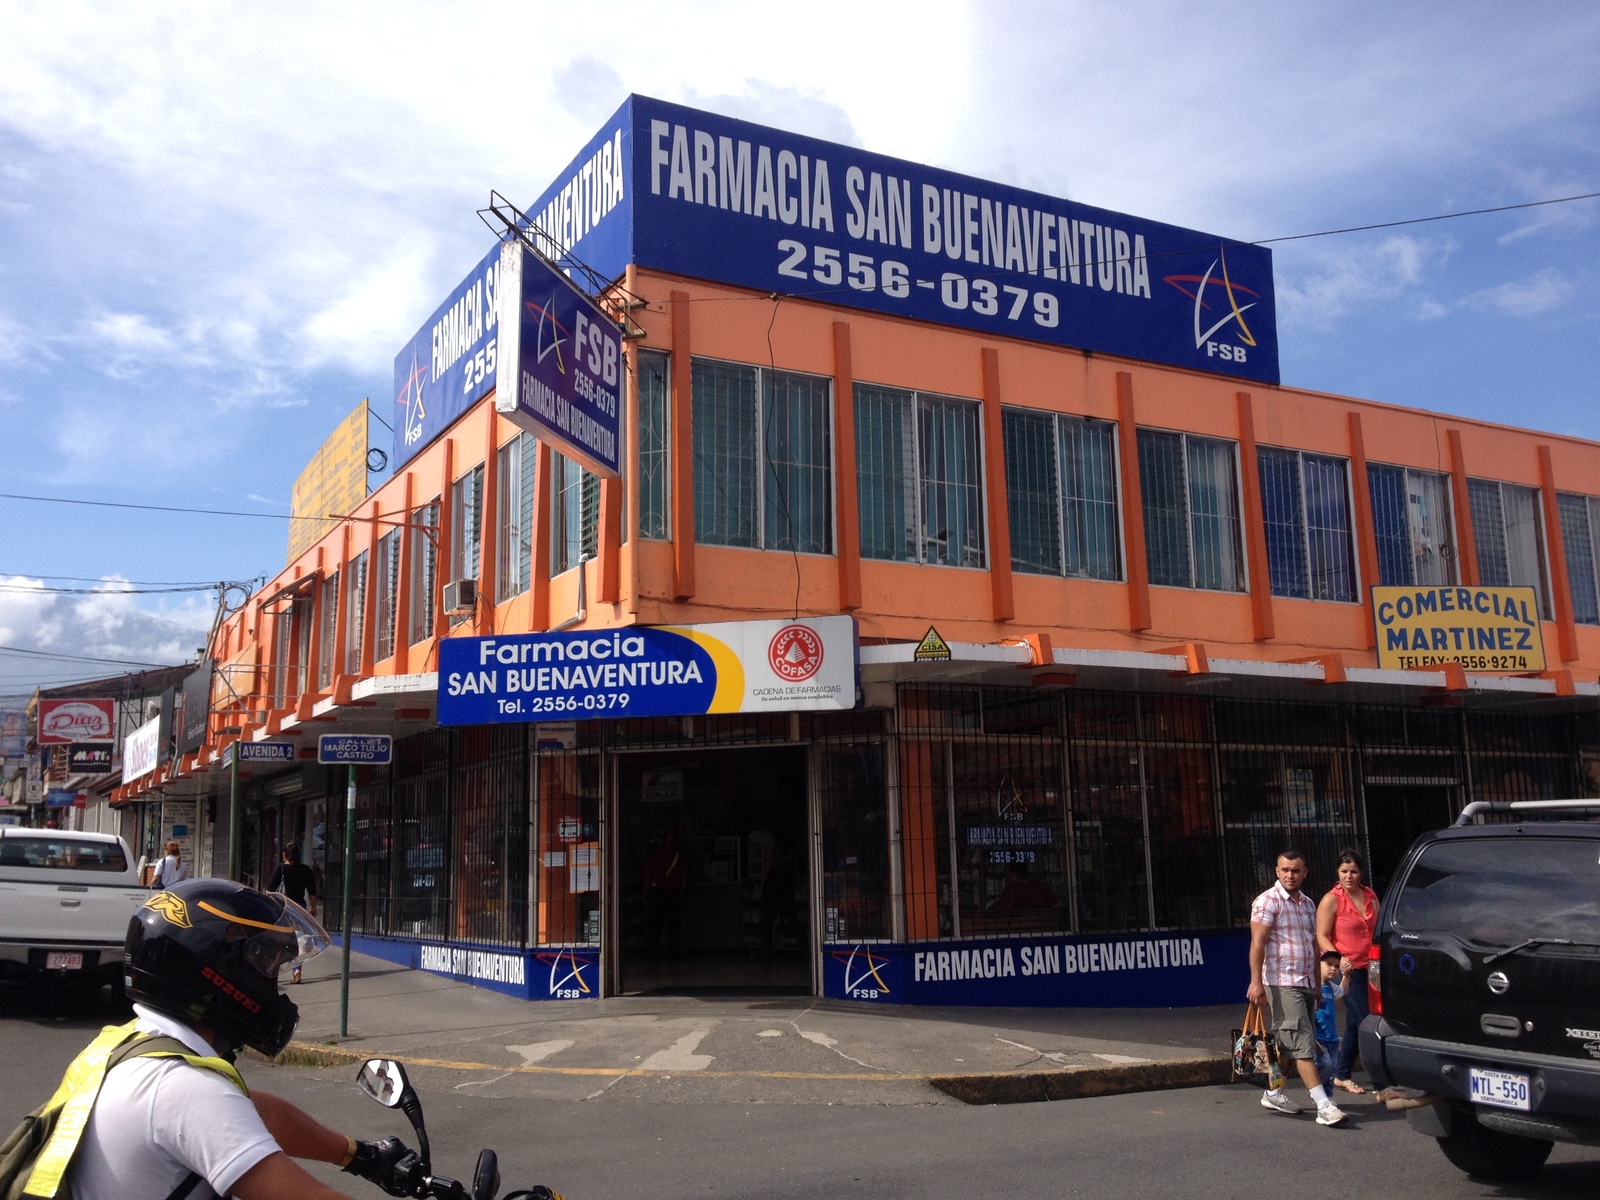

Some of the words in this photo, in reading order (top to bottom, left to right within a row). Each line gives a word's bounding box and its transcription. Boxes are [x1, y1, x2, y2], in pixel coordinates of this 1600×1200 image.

[650, 119, 834, 234] FARMACIA
[845, 166, 912, 250] SAN
[924, 183, 1152, 299] BUENAVENTURA
[777, 239, 1060, 328] 2556-0379
[432, 279, 483, 383] FARMACIA
[574, 310, 617, 387] FSB
[1207, 341, 1247, 363] FSB
[574, 368, 616, 418] 2556-0379
[522, 370, 556, 423] FARMACIA
[556, 394, 570, 433] SAN
[570, 404, 615, 463] BUENAVENTURA
[408, 424, 422, 446] FSB
[1378, 588, 1535, 627] COMERCIAL
[480, 633, 645, 666] Farmacia
[1386, 628, 1533, 651] MARTINEZ
[447, 669, 497, 696] SAN
[506, 659, 703, 694] BUENAVENTURA
[775, 655, 818, 677] COFASA
[752, 687, 784, 696] CADENA
[785, 686, 796, 695] DE
[797, 685, 842, 694] FARMACIAS
[497, 699, 525, 714] Tel.
[532, 692, 630, 713] 2556-0379
[242, 745, 285, 757] AVENIDA
[286, 746, 294, 757] 2
[324, 744, 358, 752] MARCO
[360, 744, 387, 753] TULIO
[336, 751, 374, 759] CASTRO
[1003, 812, 1024, 821] FSB
[420, 945, 452, 973] FARMACIA
[452, 949, 467, 976] SAN
[467, 950, 525, 985] BUENAVENTURA
[914, 948, 1016, 982] FARMACIA
[1020, 944, 1060, 976] SAN
[1066, 938, 1204, 974] BUENAVENTURA
[200, 966, 262, 1013] SUZUKI
[556, 990, 580, 999] FSB
[853, 989, 879, 999] FSB
[1472, 1075, 1527, 1101] NTL-550
[1480, 1095, 1518, 1106] CENTROAMERICA
